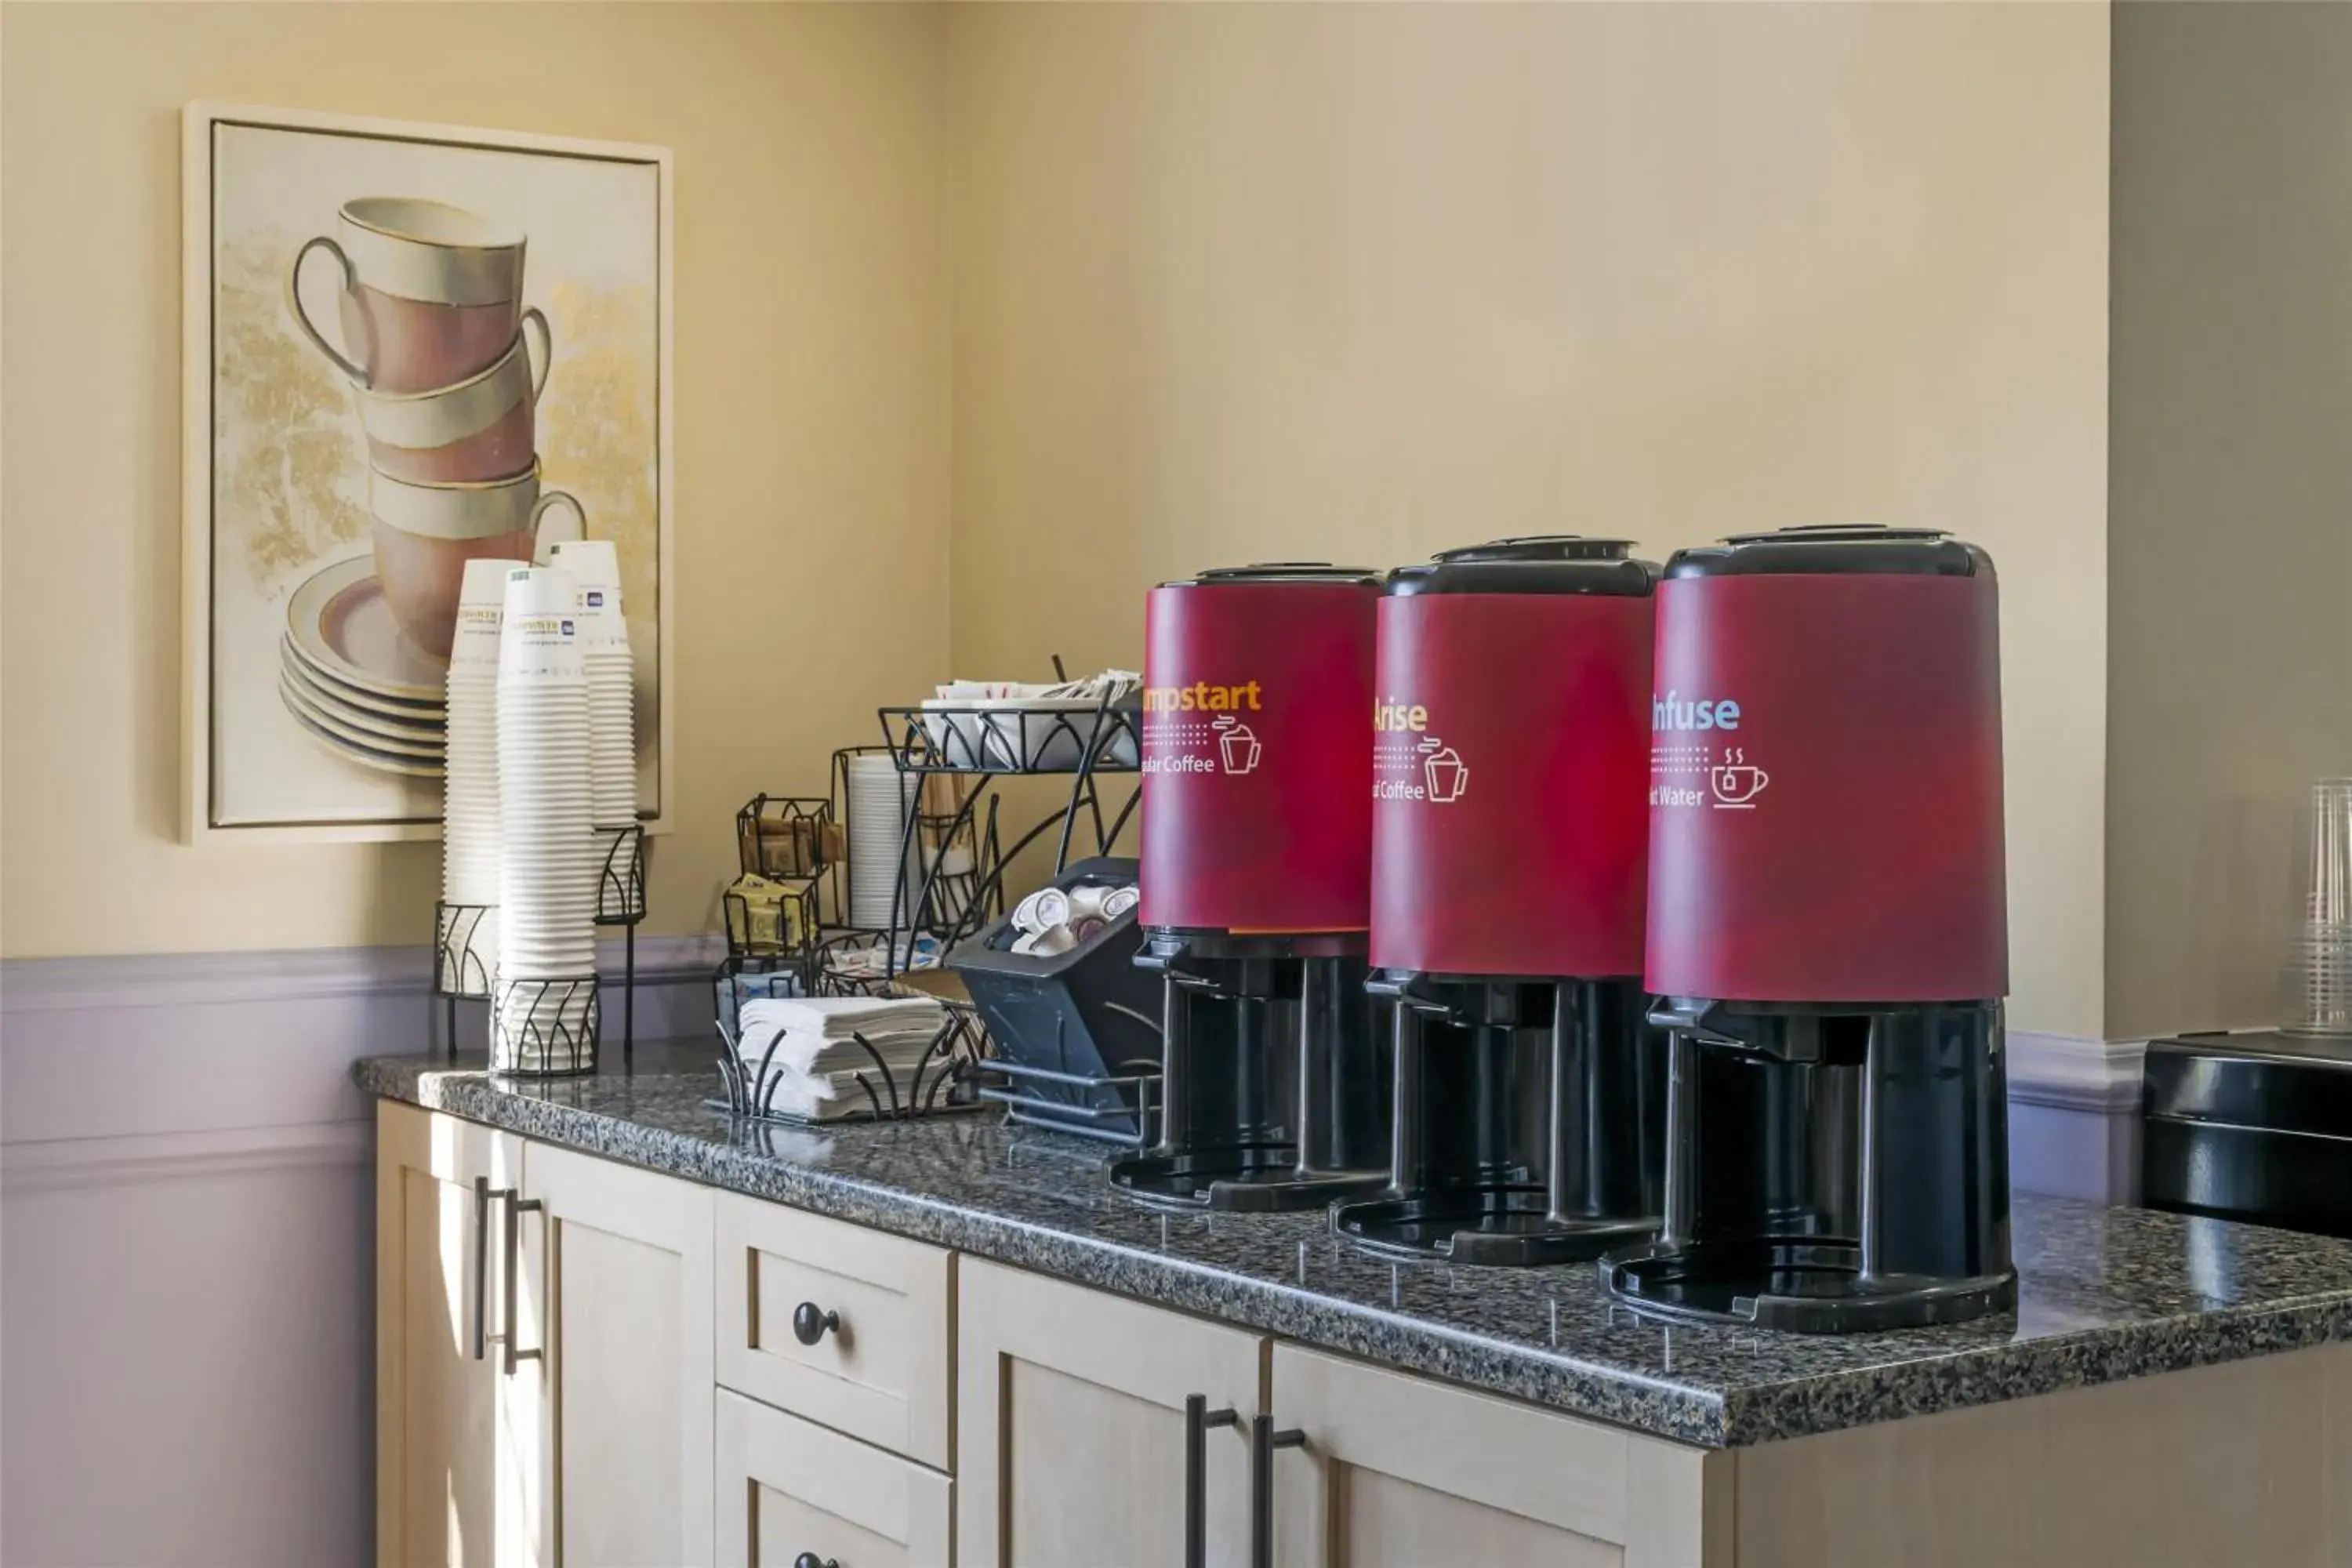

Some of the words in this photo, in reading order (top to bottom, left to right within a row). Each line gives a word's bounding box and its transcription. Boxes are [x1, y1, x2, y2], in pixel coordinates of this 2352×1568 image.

[1143, 681, 1261, 720] mpstart
[1163, 754, 1214, 773] Coffee
[1381, 779, 1425, 800] Coffee
[1658, 786, 1704, 807] Water
